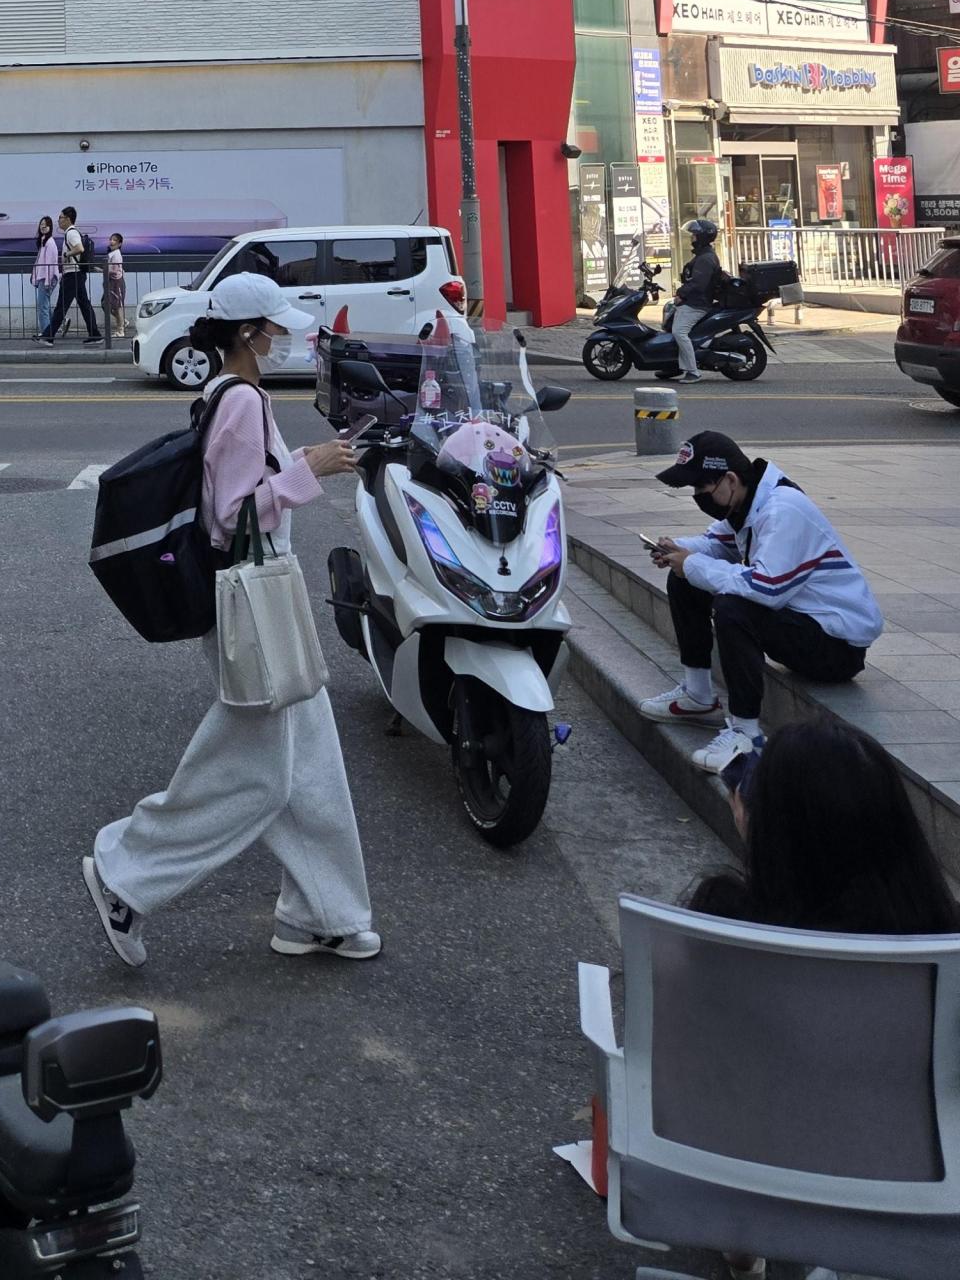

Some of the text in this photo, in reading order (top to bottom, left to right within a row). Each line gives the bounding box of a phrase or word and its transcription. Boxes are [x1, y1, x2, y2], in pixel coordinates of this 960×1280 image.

[673, 3, 762, 25] XEO HAIR 제오헤어
[777, 10, 803, 26] XEO
[804, 14, 825, 27] HAIR
[751, 63, 801, 84] baskin
[830, 69, 876, 88] robbins
[96, 162, 158, 174] iPhone 17e
[879, 165, 907, 174] Mega
[75, 177, 174, 192] 기능 가득. 실속 가득.
[881, 174, 907, 183] Time
[493, 500, 517, 511] CCTV
